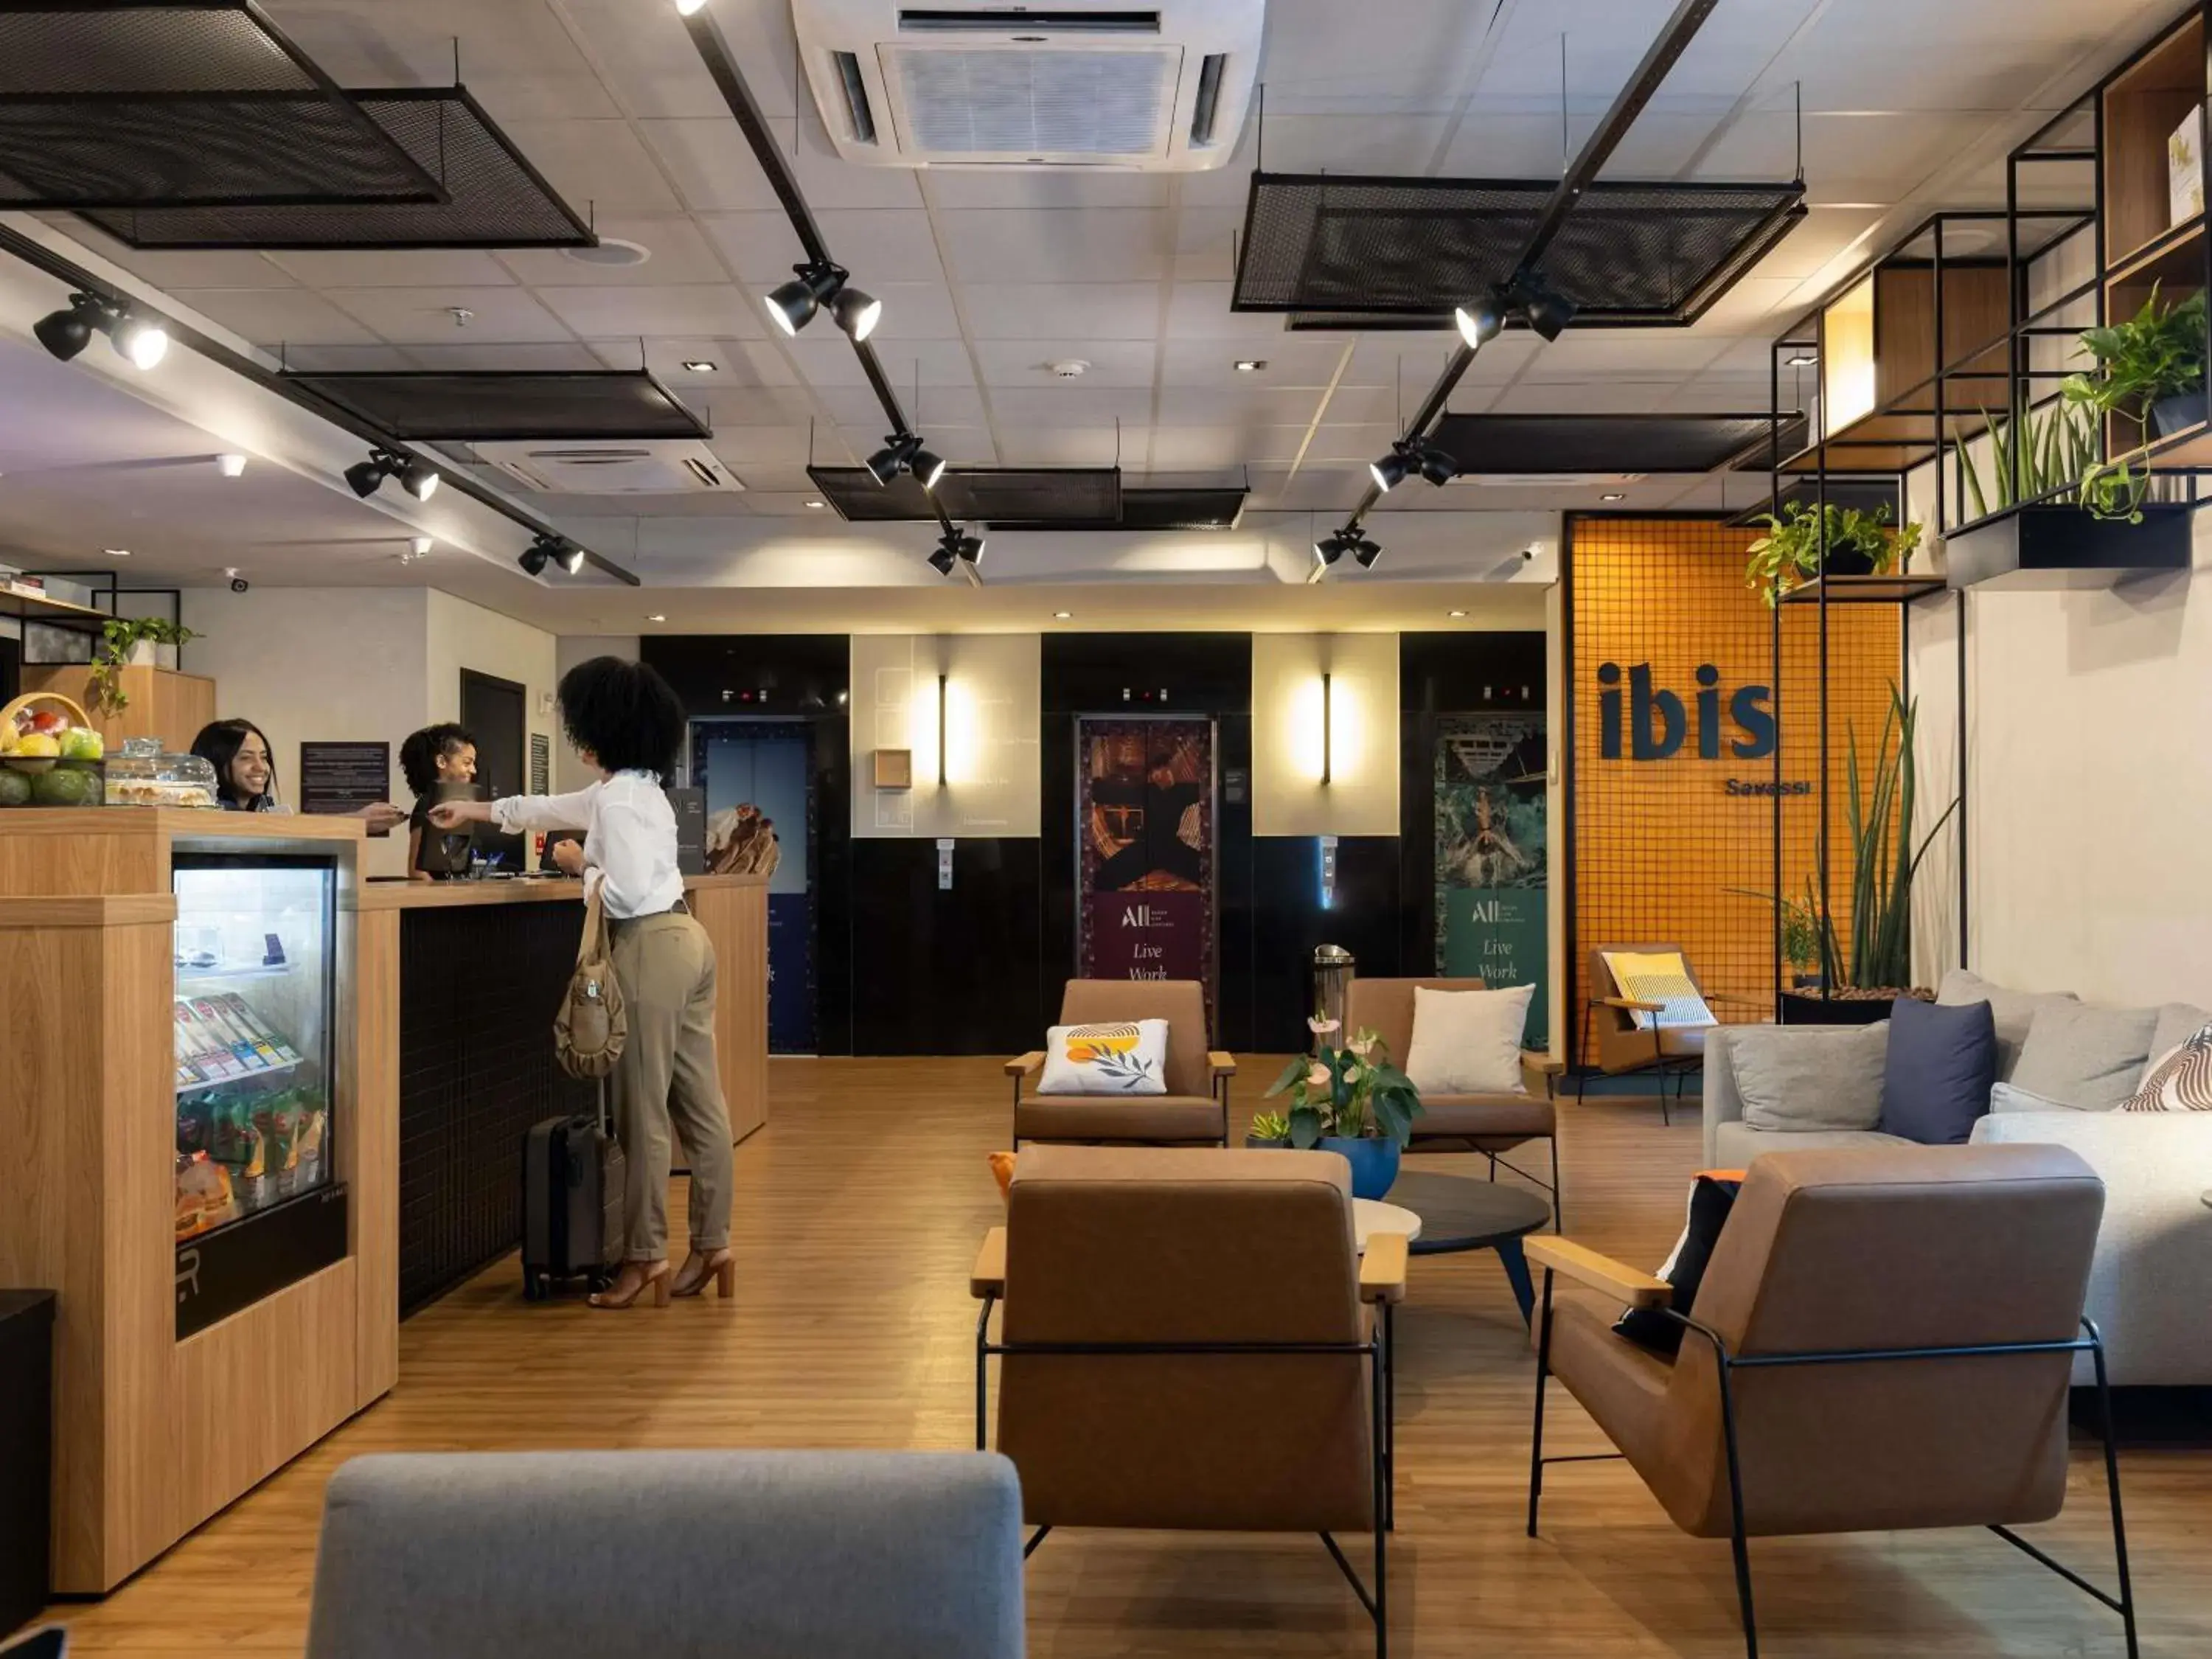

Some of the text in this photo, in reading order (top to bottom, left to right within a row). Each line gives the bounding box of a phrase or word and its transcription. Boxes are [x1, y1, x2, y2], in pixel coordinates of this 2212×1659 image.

[1598, 662, 1776, 761] ibis
[1121, 905, 1150, 927] All
[1472, 900, 1498, 923] All
[1133, 943, 1163, 959] Live
[1484, 939, 1512, 955] Live
[1129, 965, 1166, 980] Work
[1478, 961, 1517, 979] Work
